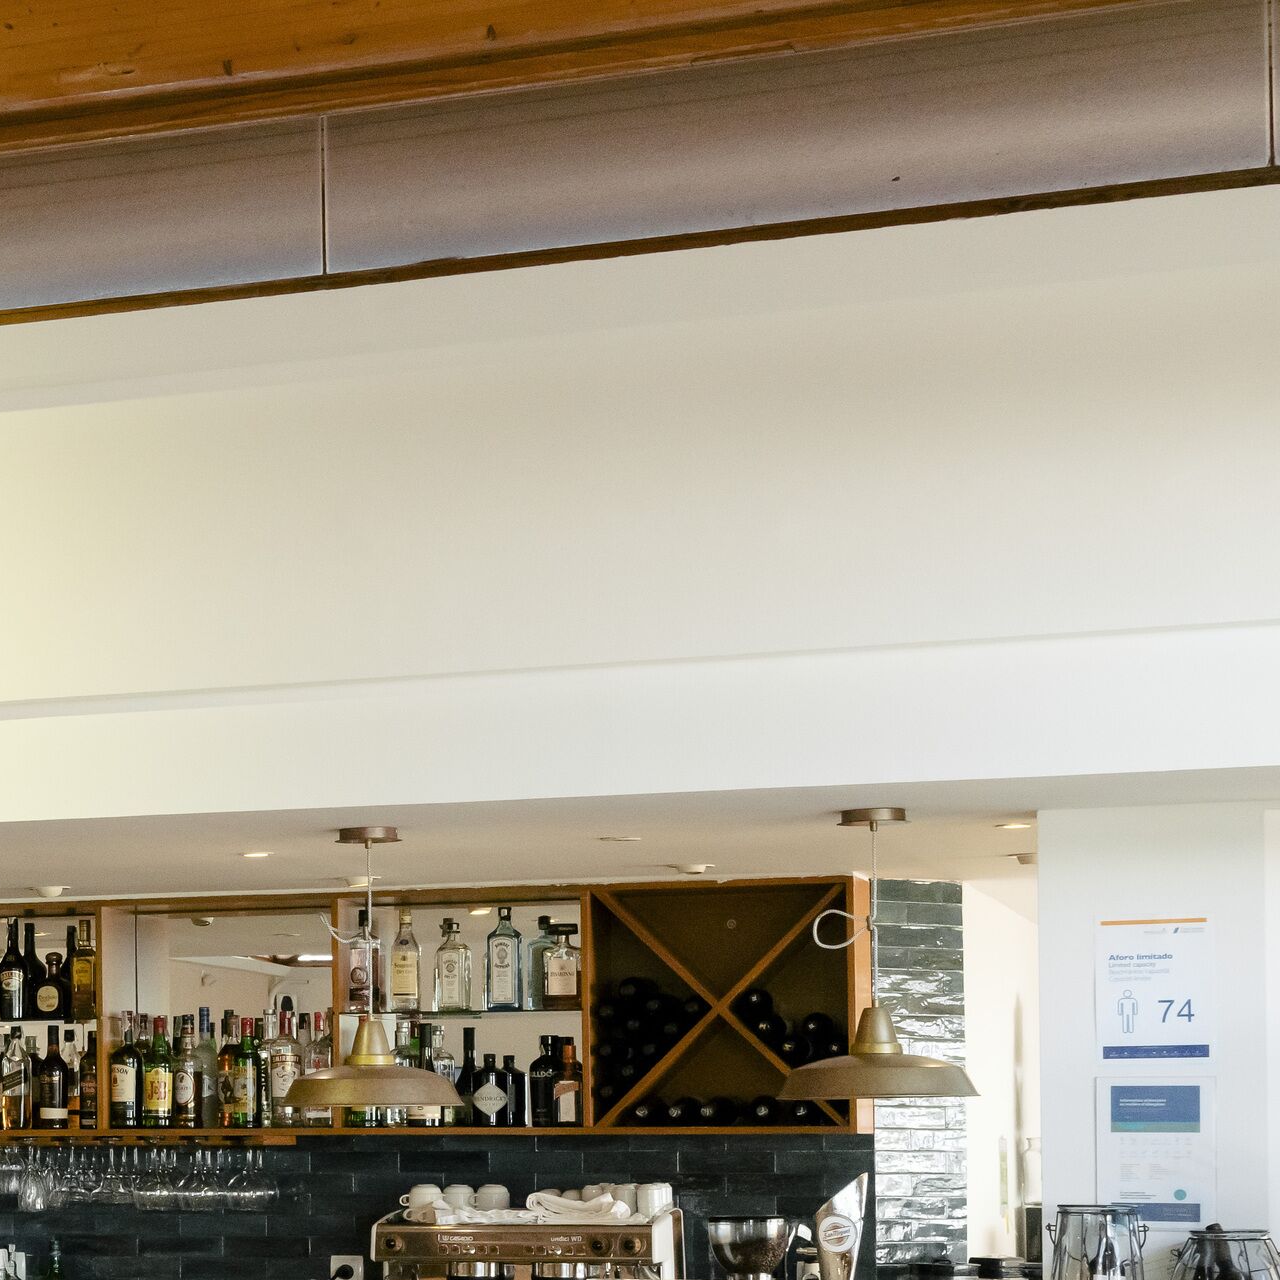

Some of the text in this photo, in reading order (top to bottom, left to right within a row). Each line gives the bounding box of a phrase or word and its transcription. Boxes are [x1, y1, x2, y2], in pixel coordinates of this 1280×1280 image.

[1108, 952, 1174, 961] Aforo limitado
[1158, 998, 1195, 1023] 74
